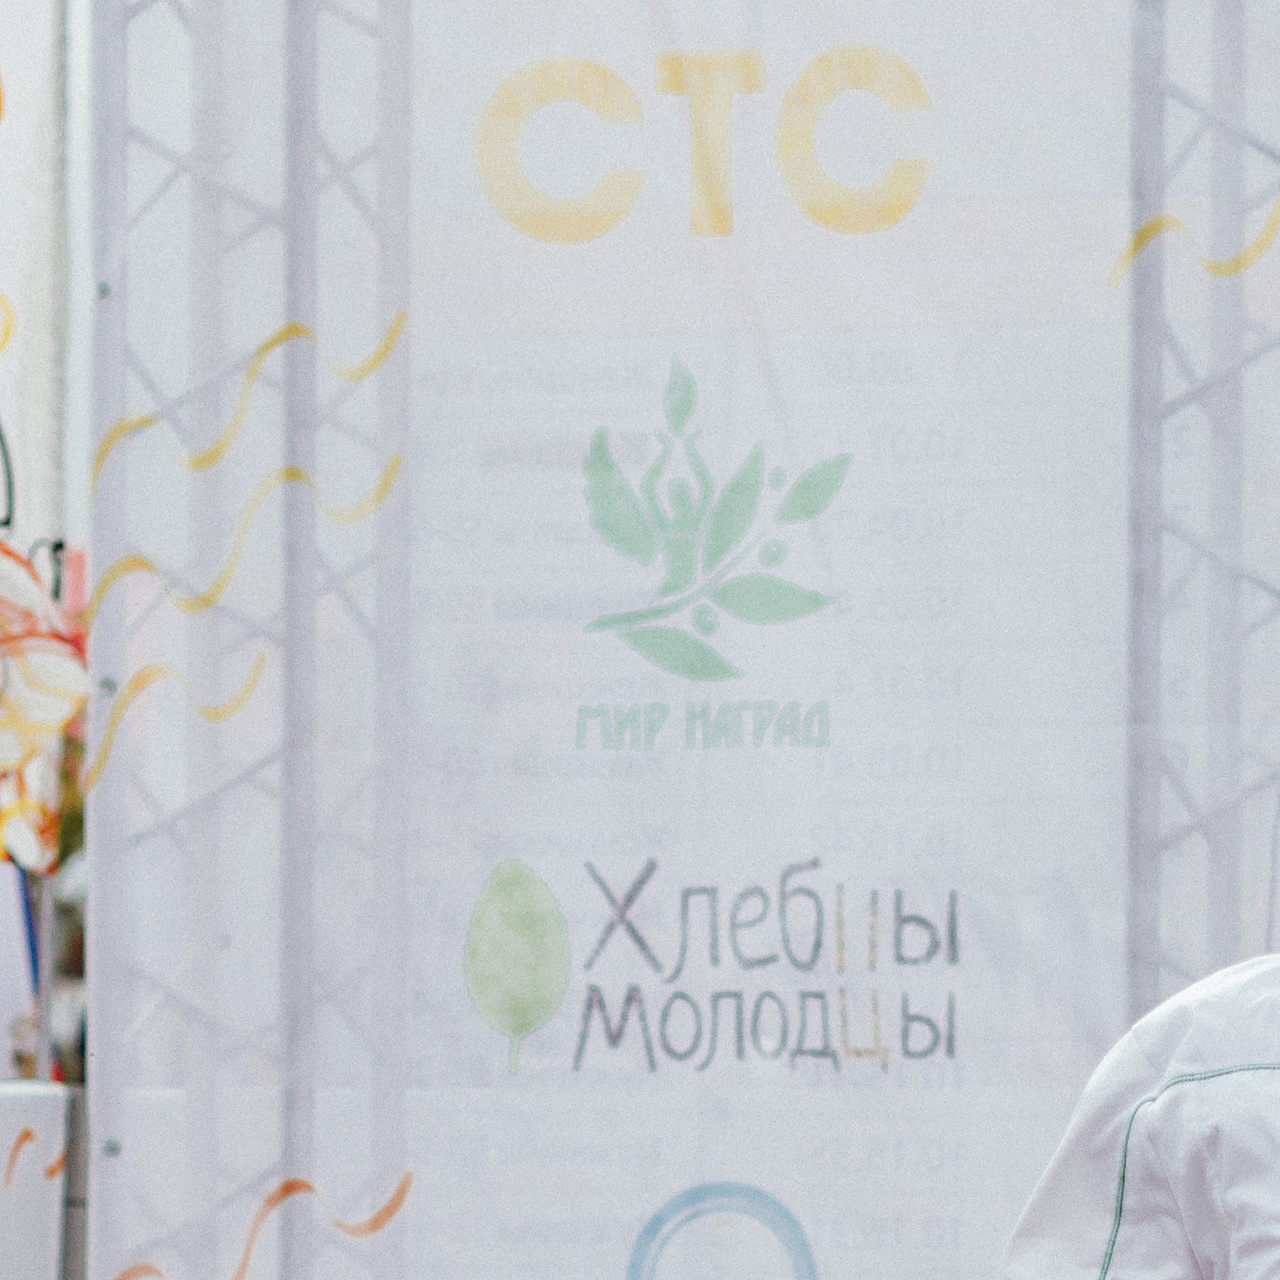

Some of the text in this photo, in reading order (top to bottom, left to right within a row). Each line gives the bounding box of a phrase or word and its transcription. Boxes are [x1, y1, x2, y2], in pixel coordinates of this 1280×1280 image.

[476, 44, 934, 245] СТС
[576, 699, 831, 750] МИР НАГРАД
[583, 857, 960, 985] Хлебцы
